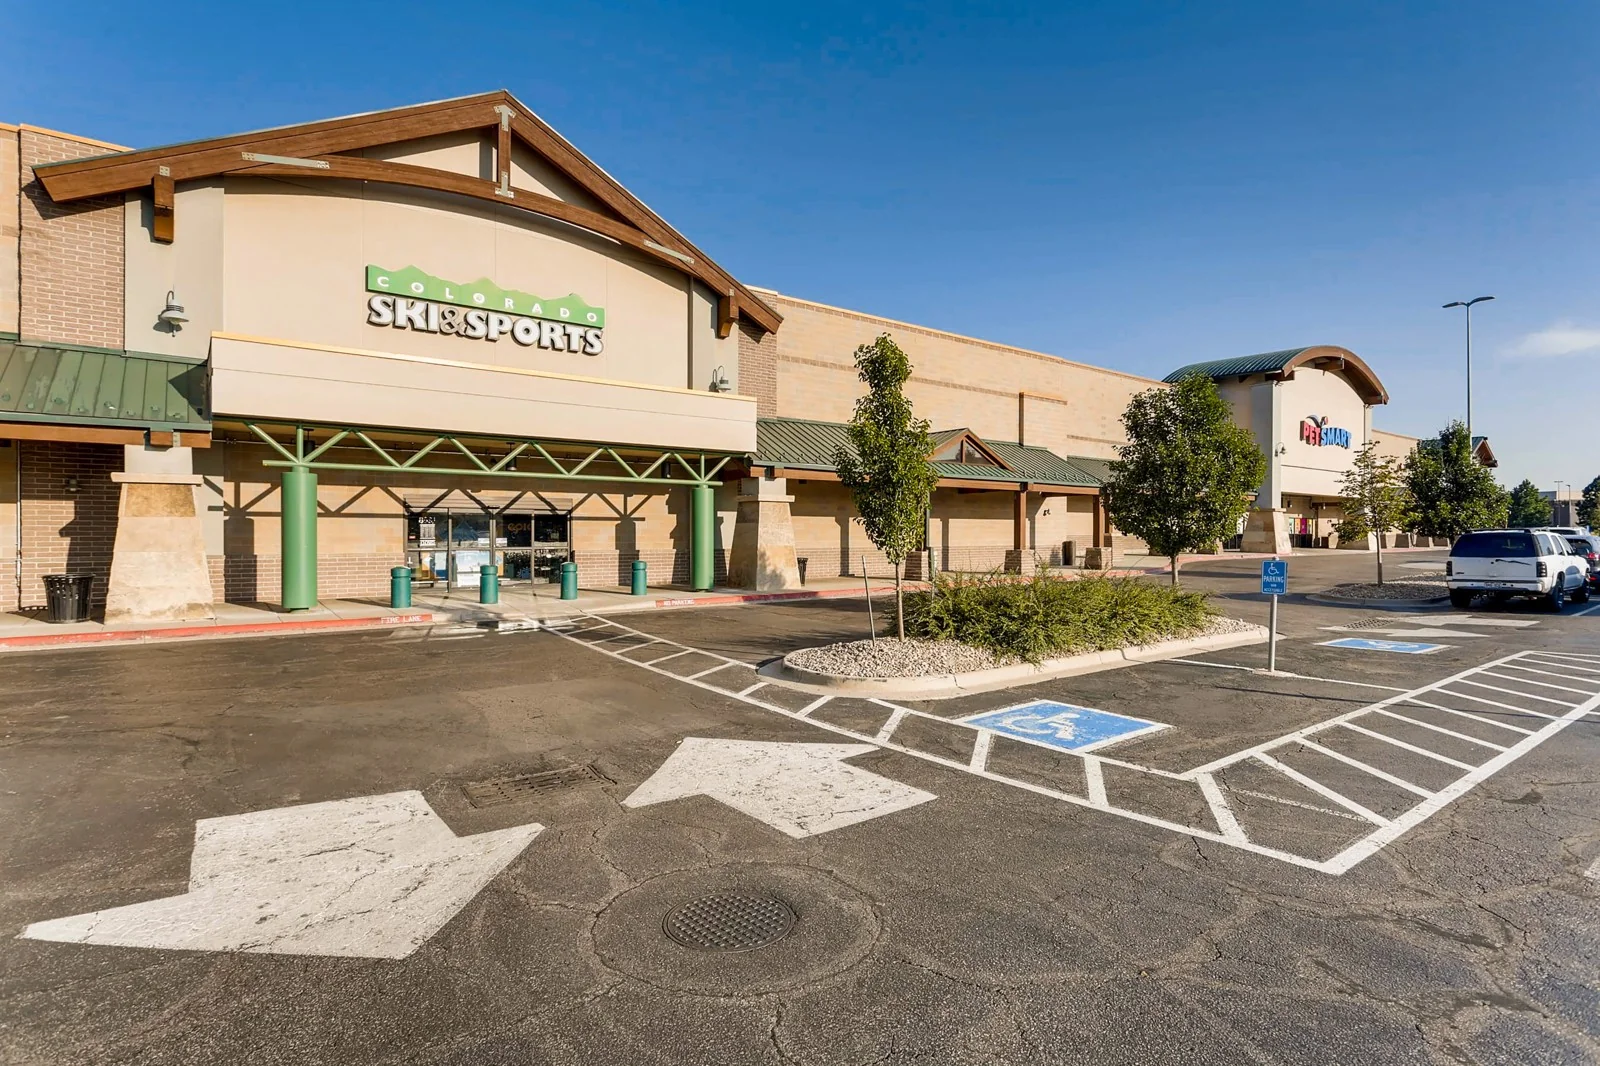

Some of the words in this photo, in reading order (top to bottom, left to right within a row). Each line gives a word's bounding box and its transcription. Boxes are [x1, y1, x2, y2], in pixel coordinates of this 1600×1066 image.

[376, 275, 598, 323] COLORADO
[367, 294, 604, 356] SKI&SPORTS
[1263, 575, 1285, 584] PARKING
[402, 615, 422, 623] LANE
